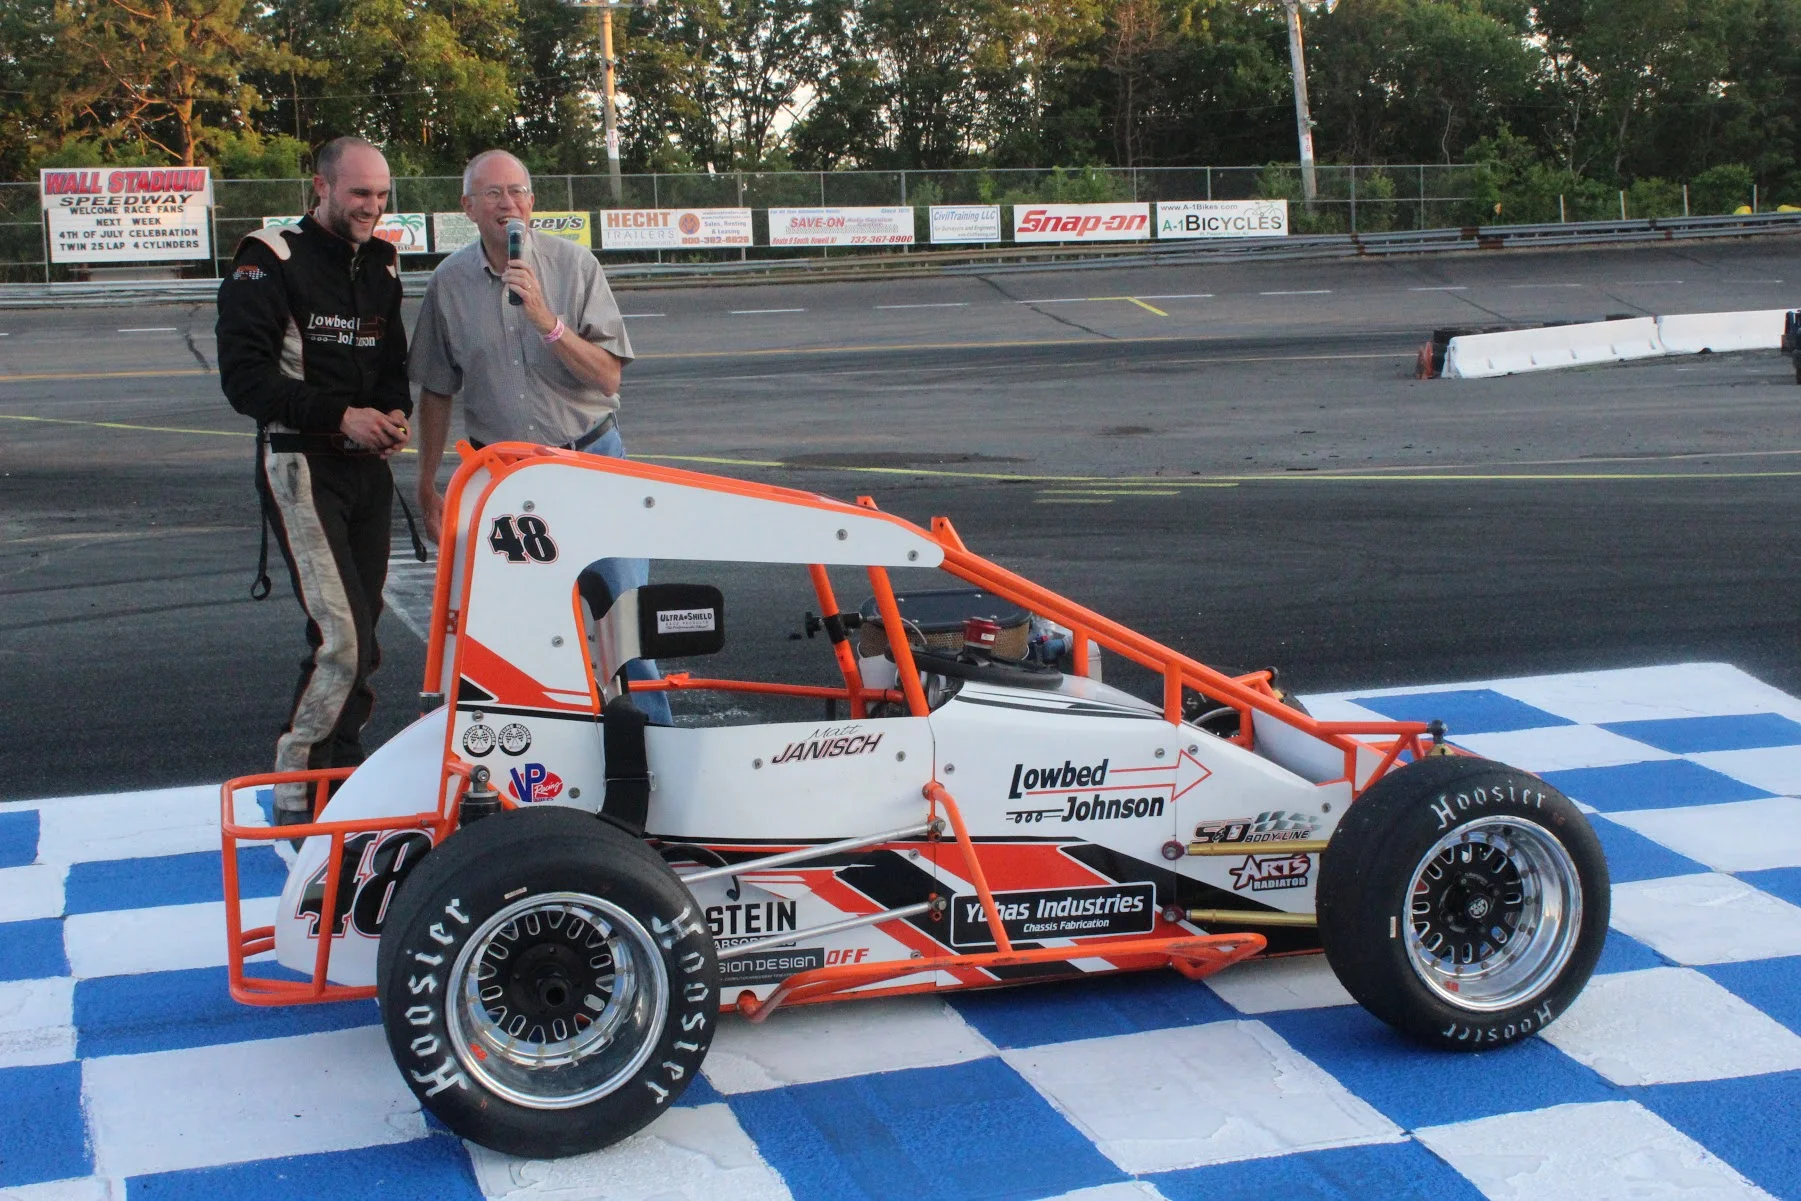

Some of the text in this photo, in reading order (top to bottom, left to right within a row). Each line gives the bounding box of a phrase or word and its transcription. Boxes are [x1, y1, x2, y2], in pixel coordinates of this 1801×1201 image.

[45, 170, 206, 194] WALL STADIUM
[60, 194, 193, 206] SPEEDWAY
[70, 206, 118, 215] WELCOME
[934, 210, 996, 222] CivilTraining LLC
[132, 218, 161, 226] WEEK
[607, 212, 670, 228] HECHT
[790, 217, 845, 228] SAVE-ON
[1016, 210, 1148, 236] Snap-on
[1162, 219, 1184, 232] A-1
[59, 231, 78, 239] 4TH
[100, 230, 123, 238] JULY
[129, 228, 198, 238] CELEBRATION
[607, 230, 674, 240] TRAILERS
[851, 235, 913, 244] 732-367-8900
[106, 242, 125, 250] LAP
[143, 240, 199, 249] CYLINDERS
[307, 313, 360, 330] Lowbed
[487, 514, 559, 564] 48
[808, 724, 863, 740] Matt
[772, 732, 884, 765] JANISCH
[510, 763, 546, 802] VP
[1008, 759, 1109, 799] Lowbed
[533, 781, 563, 796] Racing
[1062, 794, 1164, 822] Johnson
[1431, 780, 1546, 830] Hoosier
[295, 829, 433, 939] 48
[1254, 877, 1306, 890] RADIATOR
[1037, 894, 1144, 918] Industries
[1024, 919, 1109, 933] Chassis Fabrication
[756, 956, 816, 970] DESIGN
[825, 948, 869, 965] OFF
[405, 898, 469, 1098] Hoosier
[647, 906, 704, 1103] Hoosier
[1443, 1000, 1552, 1042] Hoosier
